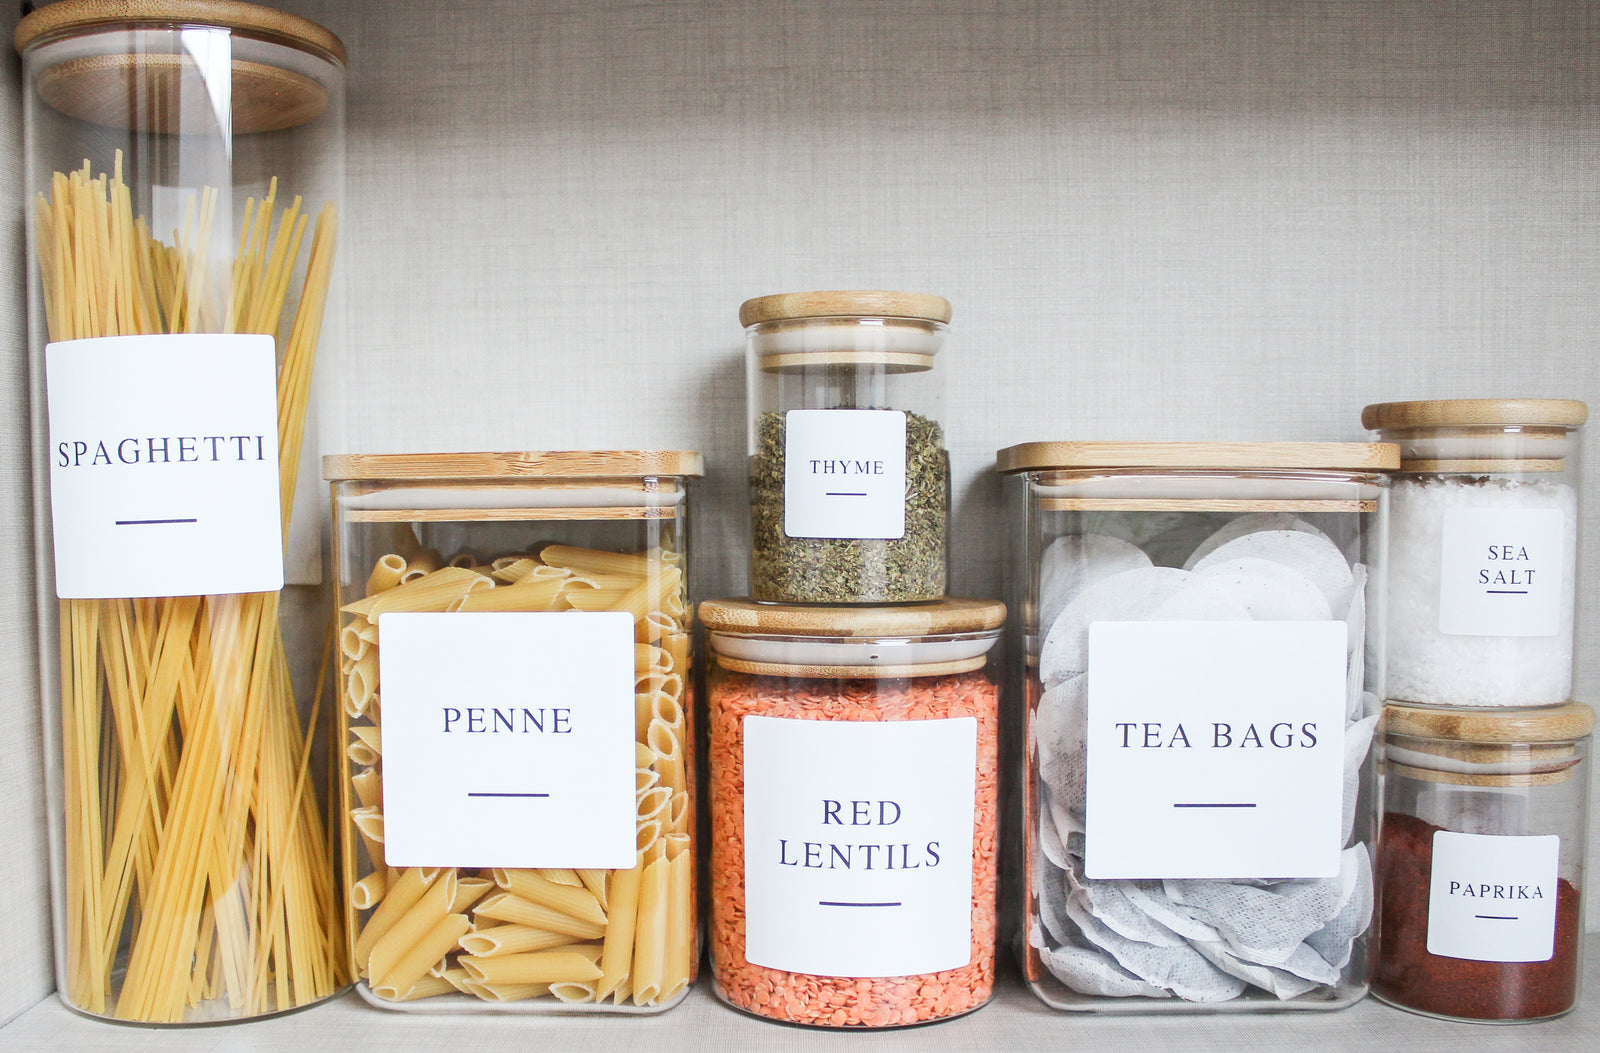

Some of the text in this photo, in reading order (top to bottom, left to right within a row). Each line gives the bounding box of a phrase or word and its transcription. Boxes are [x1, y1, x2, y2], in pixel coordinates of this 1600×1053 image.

[58, 435, 266, 468] SPAGHETTI
[809, 459, 885, 475] THYME
[1487, 545, 1530, 561] SEA
[1478, 568, 1536, 585] SALT
[442, 707, 574, 734] PENNE
[1115, 722, 1319, 749] TEA BAGS
[822, 799, 903, 826] RED
[779, 839, 941, 870] LENTILS
[1449, 880, 1544, 900] PAPRIKA
